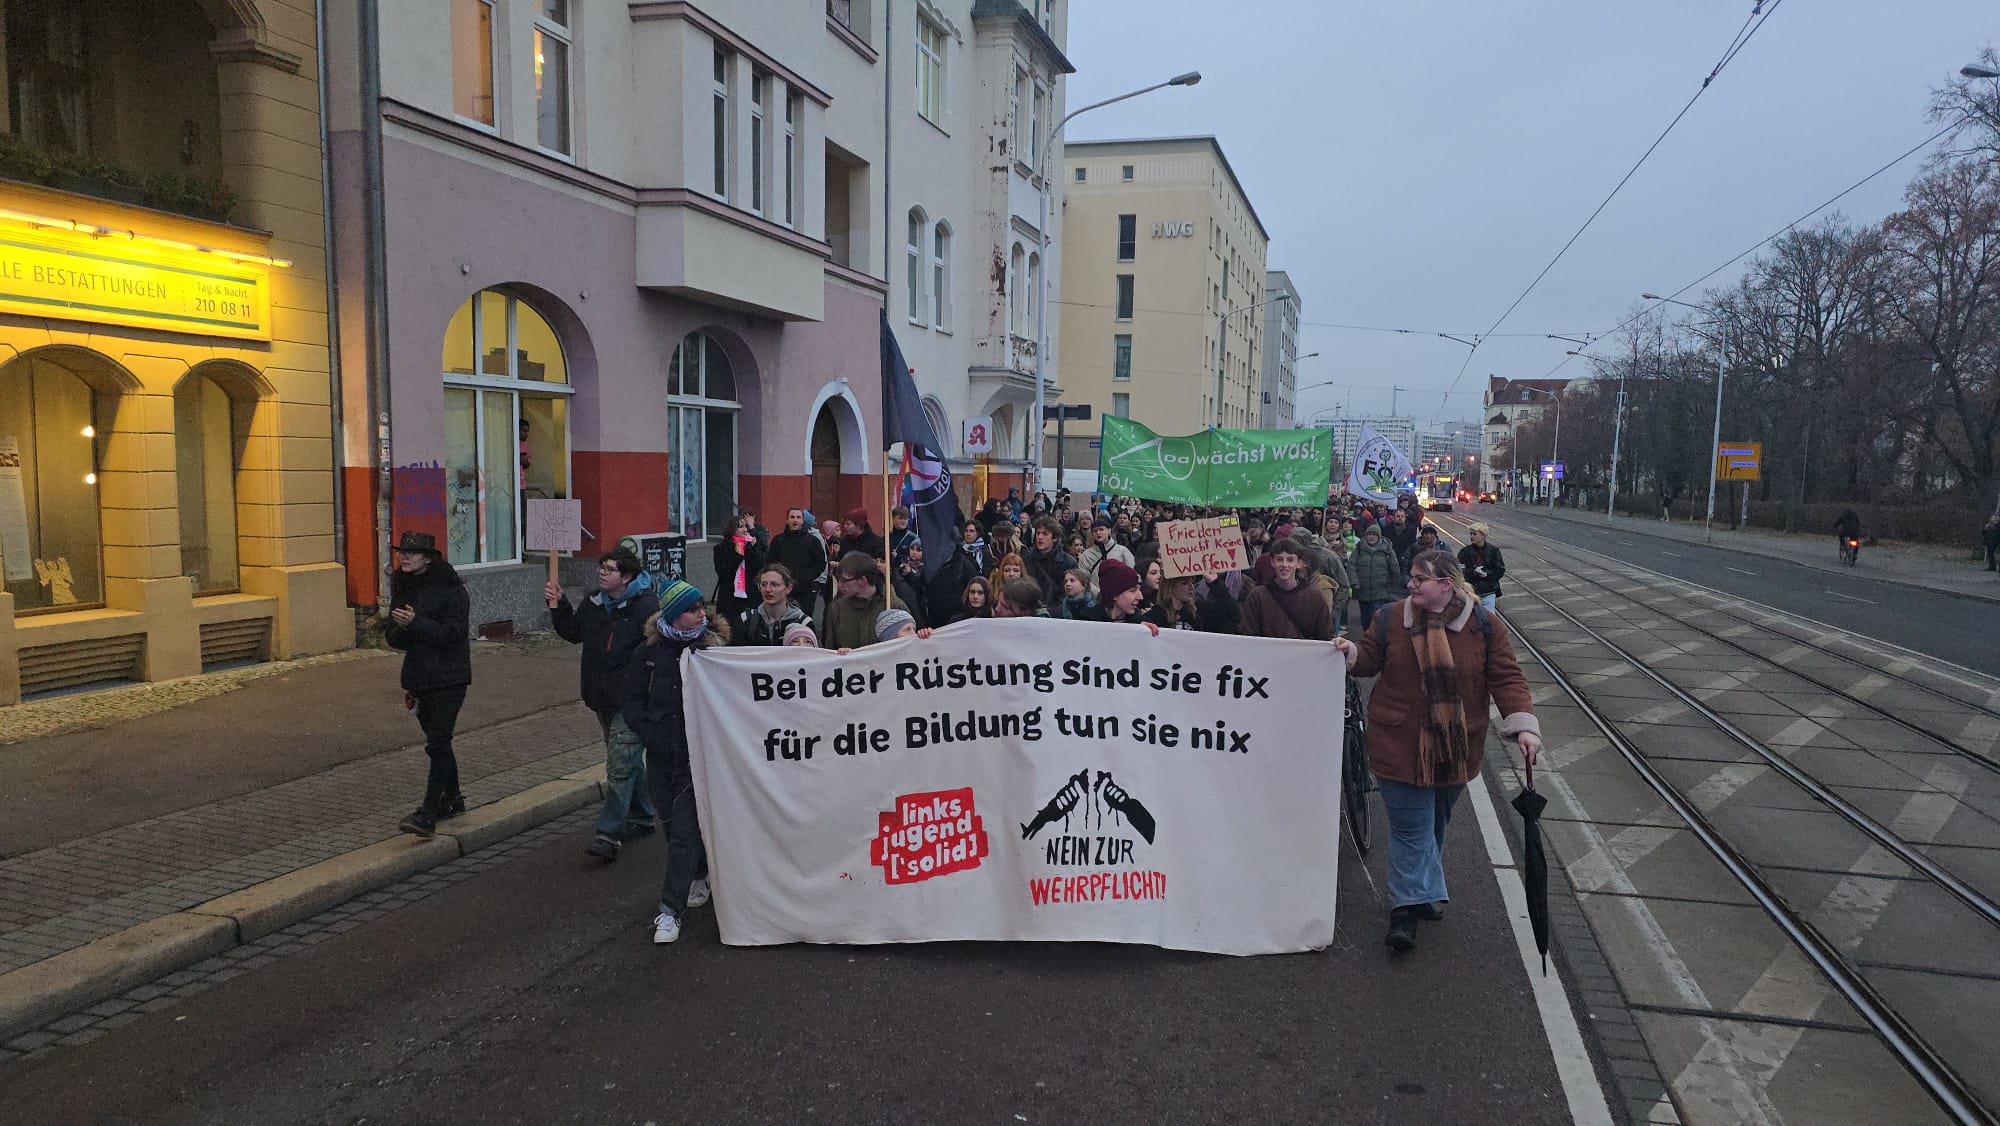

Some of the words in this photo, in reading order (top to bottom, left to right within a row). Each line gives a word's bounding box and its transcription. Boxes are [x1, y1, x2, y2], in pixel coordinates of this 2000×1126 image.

[1151, 221, 1193, 239] HWG
[0, 260, 22, 280] LE
[33, 265, 167, 299] BESTATTUNGEN
[197, 282, 213, 296] Tag
[215, 284, 221, 295] &
[224, 285, 248, 299] Nacht
[195, 297, 216, 313] 210
[221, 300, 237, 316] 08
[240, 304, 251, 318] 11
[1164, 454, 1190, 465] Da
[1197, 444, 1265, 465] wächst
[1273, 436, 1317, 461] was!
[1102, 473, 1134, 492] FÖJ:
[1168, 523, 1222, 540] Frieden
[1166, 540, 1210, 556] braucht
[750, 668, 807, 701] Bei
[821, 668, 885, 698] der
[895, 657, 1054, 693] Rüstung
[1149, 663, 1202, 694] sie
[1216, 665, 1270, 699] fix
[763, 728, 822, 761] für
[833, 722, 891, 756] die
[905, 706, 1043, 749] Bildung
[1054, 708, 1119, 739] tun
[1132, 713, 1180, 748] sie
[1191, 720, 1252, 754] nix
[902, 797, 963, 827] links
[881, 810, 973, 861] jugend
[1046, 836, 1090, 866] NEIN
[1094, 836, 1135, 866] ZUR
[1030, 870, 1167, 906] WEHRPFLICHT!
